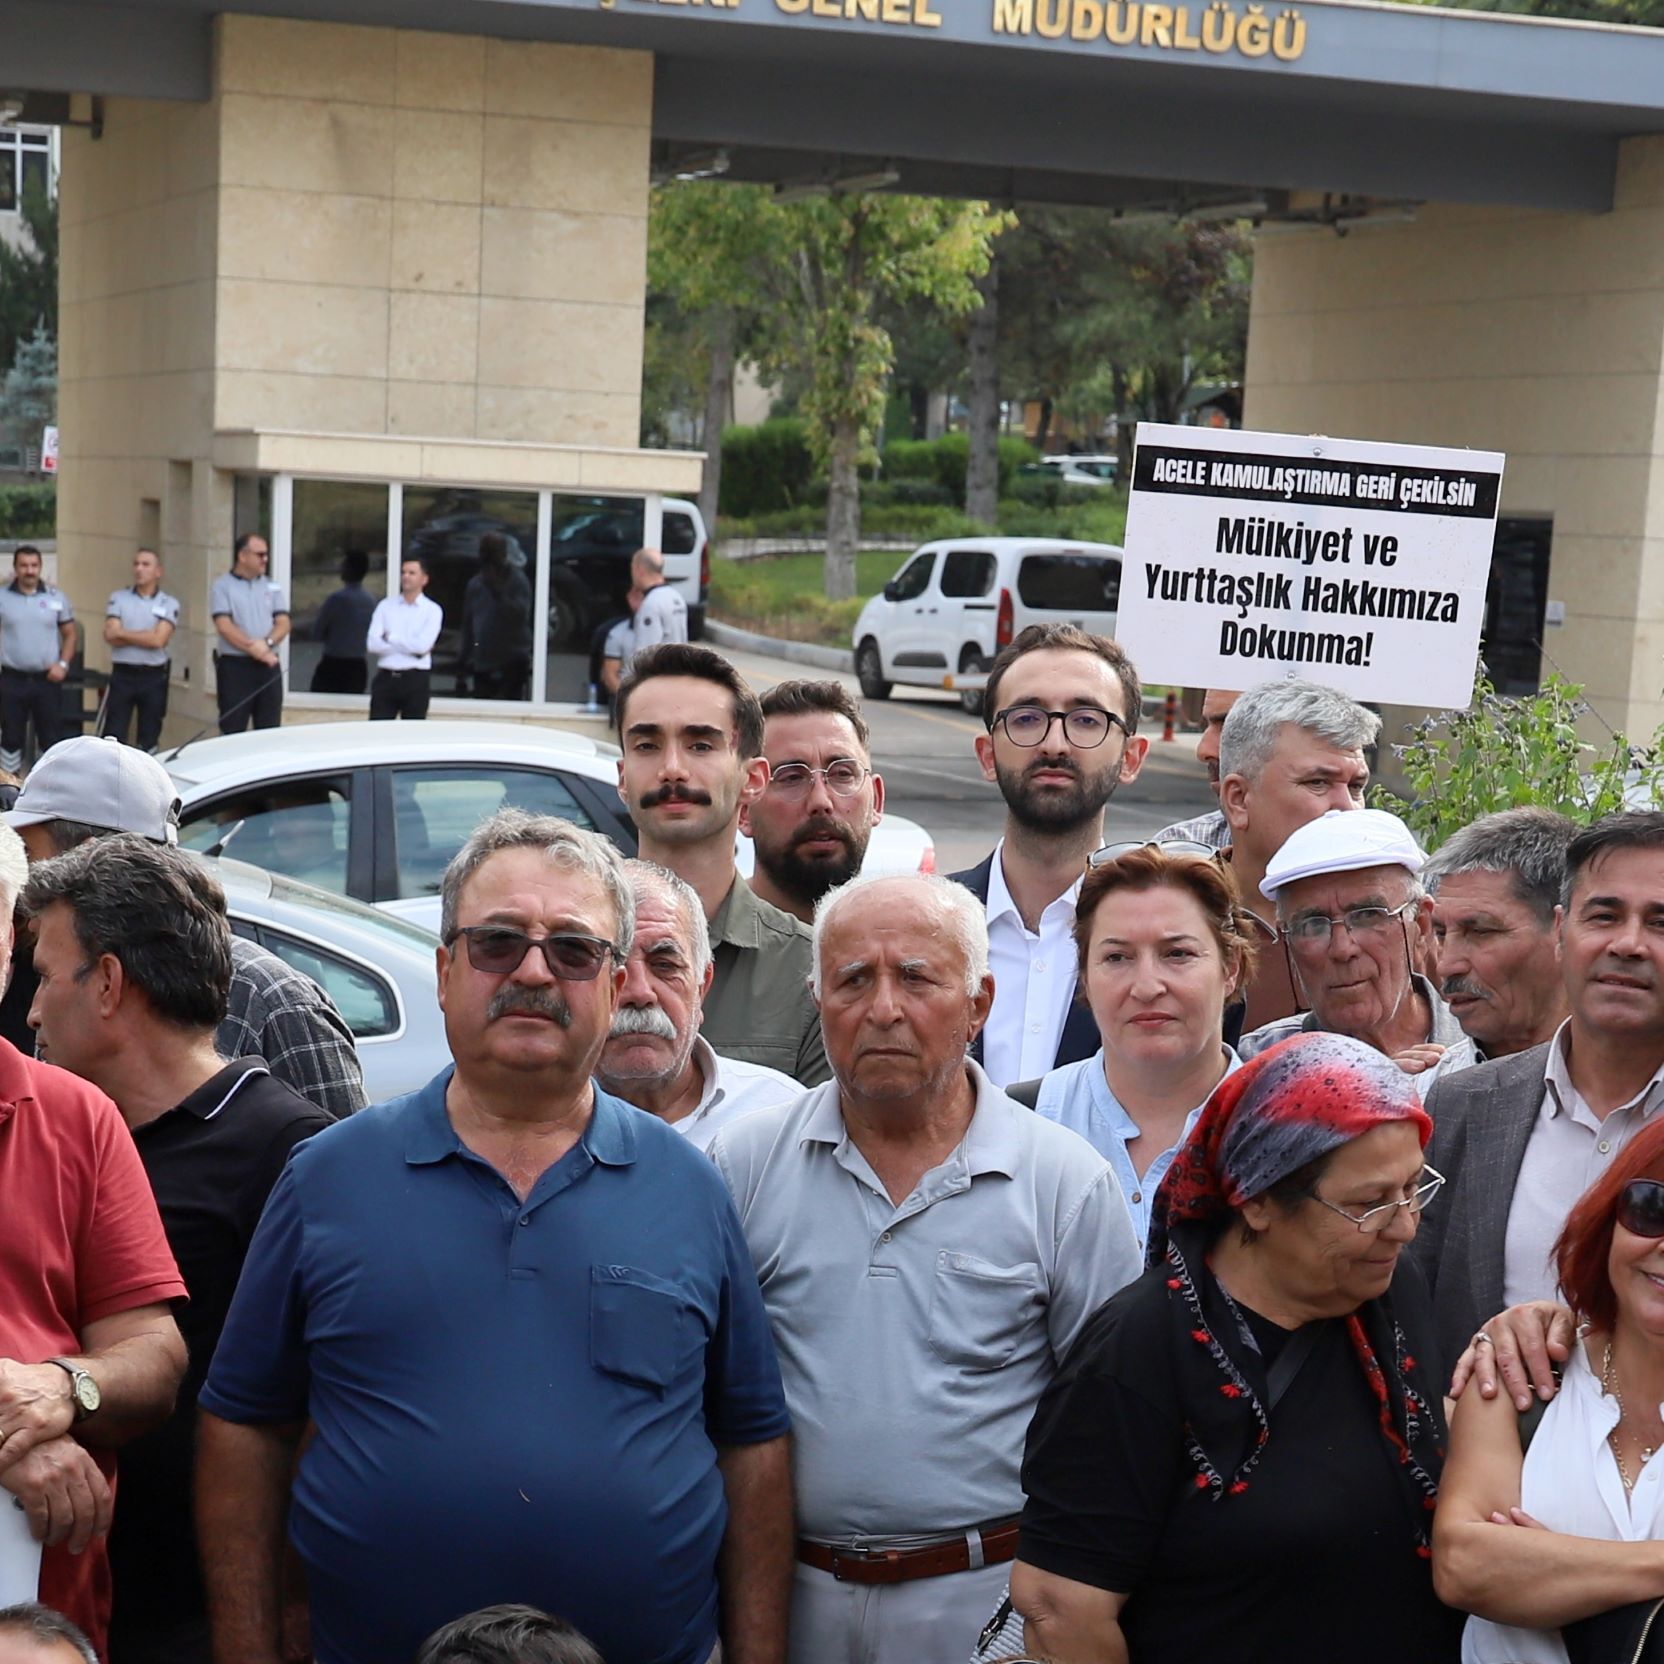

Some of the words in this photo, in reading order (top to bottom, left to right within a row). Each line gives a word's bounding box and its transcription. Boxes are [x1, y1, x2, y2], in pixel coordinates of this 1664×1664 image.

[1153, 458, 1206, 486] ACELE
[1210, 462, 1351, 499] KAMULAŞTIRMA
[1355, 471, 1397, 501] GERİ
[1399, 475, 1476, 508] ÇEKİLSİN
[1216, 517, 1353, 565] Mülkiyet
[1362, 533, 1399, 567] ve
[1145, 562, 1293, 619] Yurttaşlık
[1301, 575, 1460, 624] Hakkımıza
[1218, 621, 1374, 667] Dokunma!
